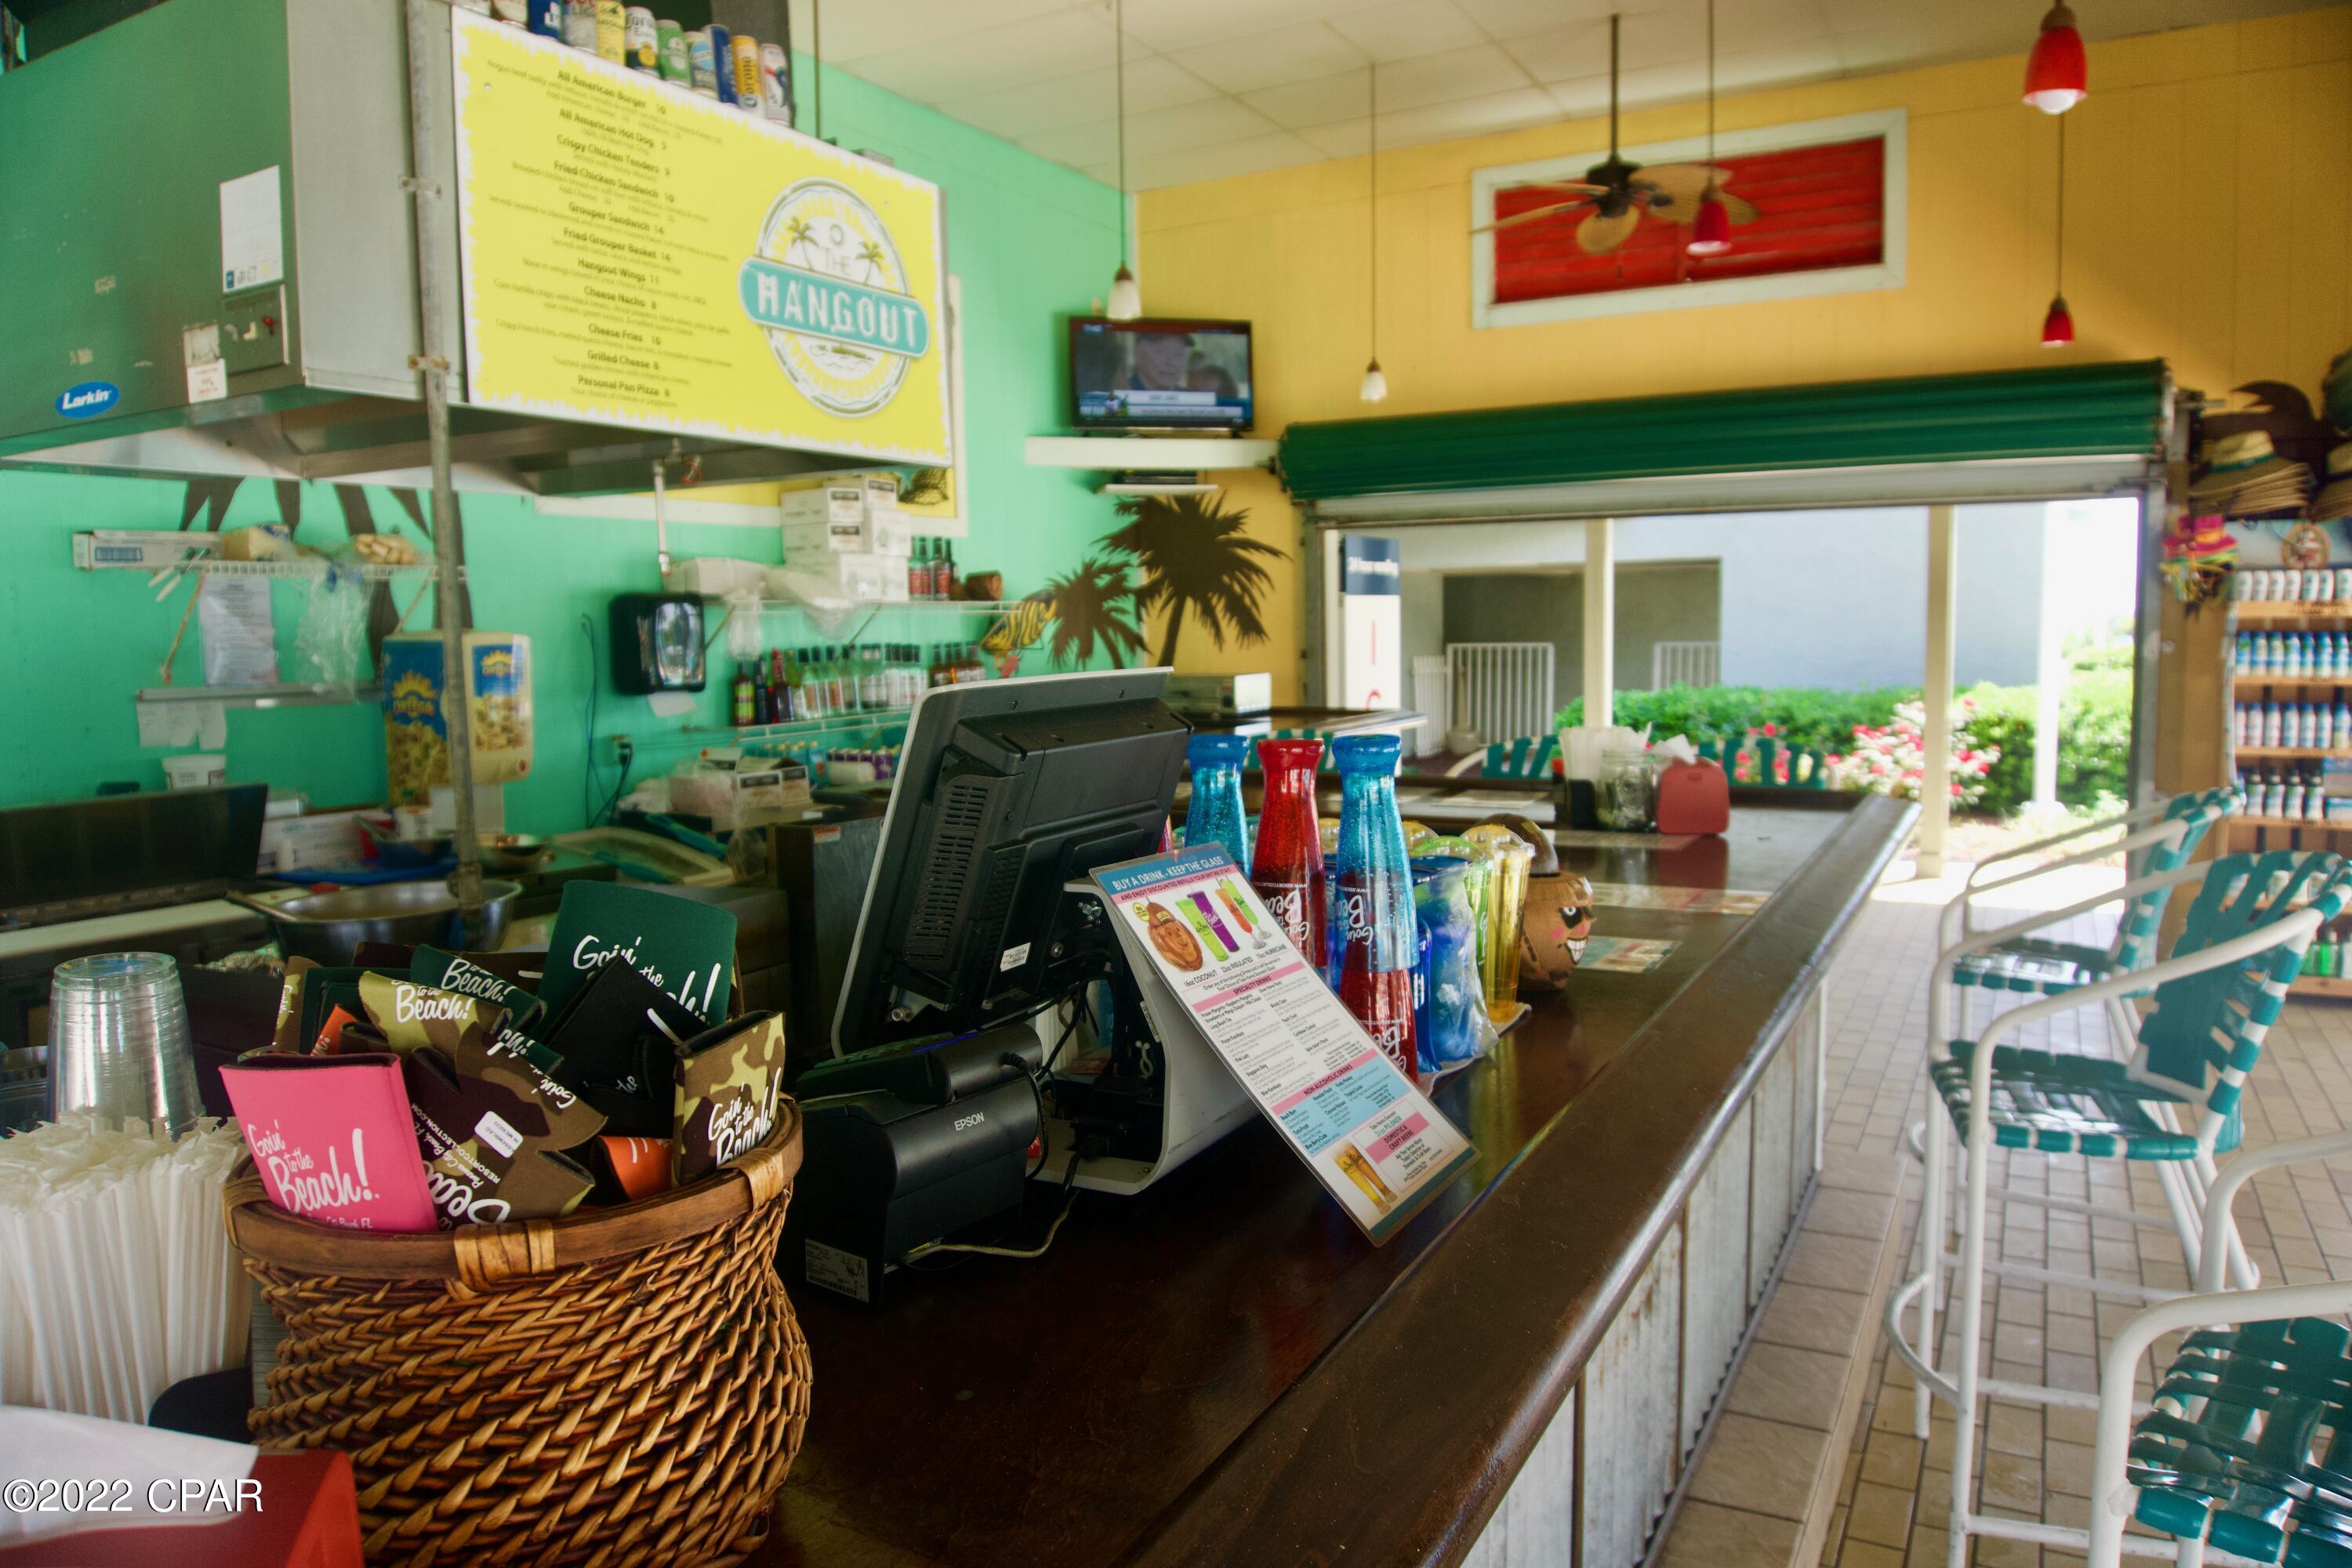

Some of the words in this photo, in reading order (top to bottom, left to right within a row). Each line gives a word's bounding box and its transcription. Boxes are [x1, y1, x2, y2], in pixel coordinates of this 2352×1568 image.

[557, 69, 571, 82] All
[572, 75, 615, 98] American
[617, 89, 646, 109] Burger
[742, 56, 757, 108] Corona
[559, 107, 573, 121] All
[574, 114, 617, 133] American
[619, 127, 634, 141] Hot
[635, 133, 655, 149] Dog
[557, 134, 586, 153] Crispy
[588, 143, 624, 163] Chicken
[626, 154, 659, 174] Tenders
[554, 159, 578, 176] Fried
[579, 167, 616, 187] Chicken
[618, 178, 659, 199] Sandwich
[568, 201, 606, 221] Grouper
[608, 211, 651, 233] Sandwich
[563, 227, 587, 242] Fried
[589, 233, 626, 252] Grouper
[627, 242, 657, 260] Basket
[577, 256, 618, 276] Hangout
[619, 267, 646, 284] Wings
[822, 247, 851, 274] THE
[583, 284, 616, 303] Cheese
[618, 292, 646, 308] Nacho
[757, 272, 917, 347] HANGOUT
[587, 322, 621, 339] Cheese
[622, 328, 644, 343] Fries
[586, 348, 618, 364] Grilled
[619, 354, 651, 370] Cheese
[62, 390, 111, 410] Larkin
[577, 373, 617, 390] Personal
[618, 380, 636, 393] Pan
[636, 383, 660, 397] Pizza
[1112, 878, 1131, 890] BUY
[1131, 877, 1140, 886] A
[1138, 871, 1165, 884] DRINK
[1167, 865, 1185, 876] KEEP
[1185, 862, 1202, 871] THE
[1200, 856, 1223, 868] GLASS
[1131, 889, 1147, 898] ENJOY
[1147, 881, 1178, 893] DISCOUNTED
[1194, 970, 1217, 983] COCONUT
[1230, 956, 1253, 968] INSULATED
[1265, 944, 1287, 955] HURRICANE
[441, 957, 518, 1004] Beach!
[1233, 982, 1256, 995] SPECIALTY
[1255, 975, 1272, 985] DRINKS
[395, 984, 477, 1023] Beach!
[1304, 1073, 1339, 1095] NON-ALCOHOLIC
[1337, 1065, 1352, 1076] DRINKS
[708, 1081, 745, 1141] Goin'
[954, 1112, 985, 1132] EPSON
[248, 1118, 287, 1158] Goin'
[408, 1101, 501, 1186] RESORTCOLLECTION.COM
[419, 1131, 446, 1156] Beach,
[1384, 1127, 1404, 1143] DOMESTIC
[1389, 1138, 1402, 1150] CRAFT
[1401, 1130, 1414, 1141] BEERS
[268, 1127, 374, 1214] Beach!
[439, 1148, 461, 1169] City
[453, 1160, 484, 1190] Panama
